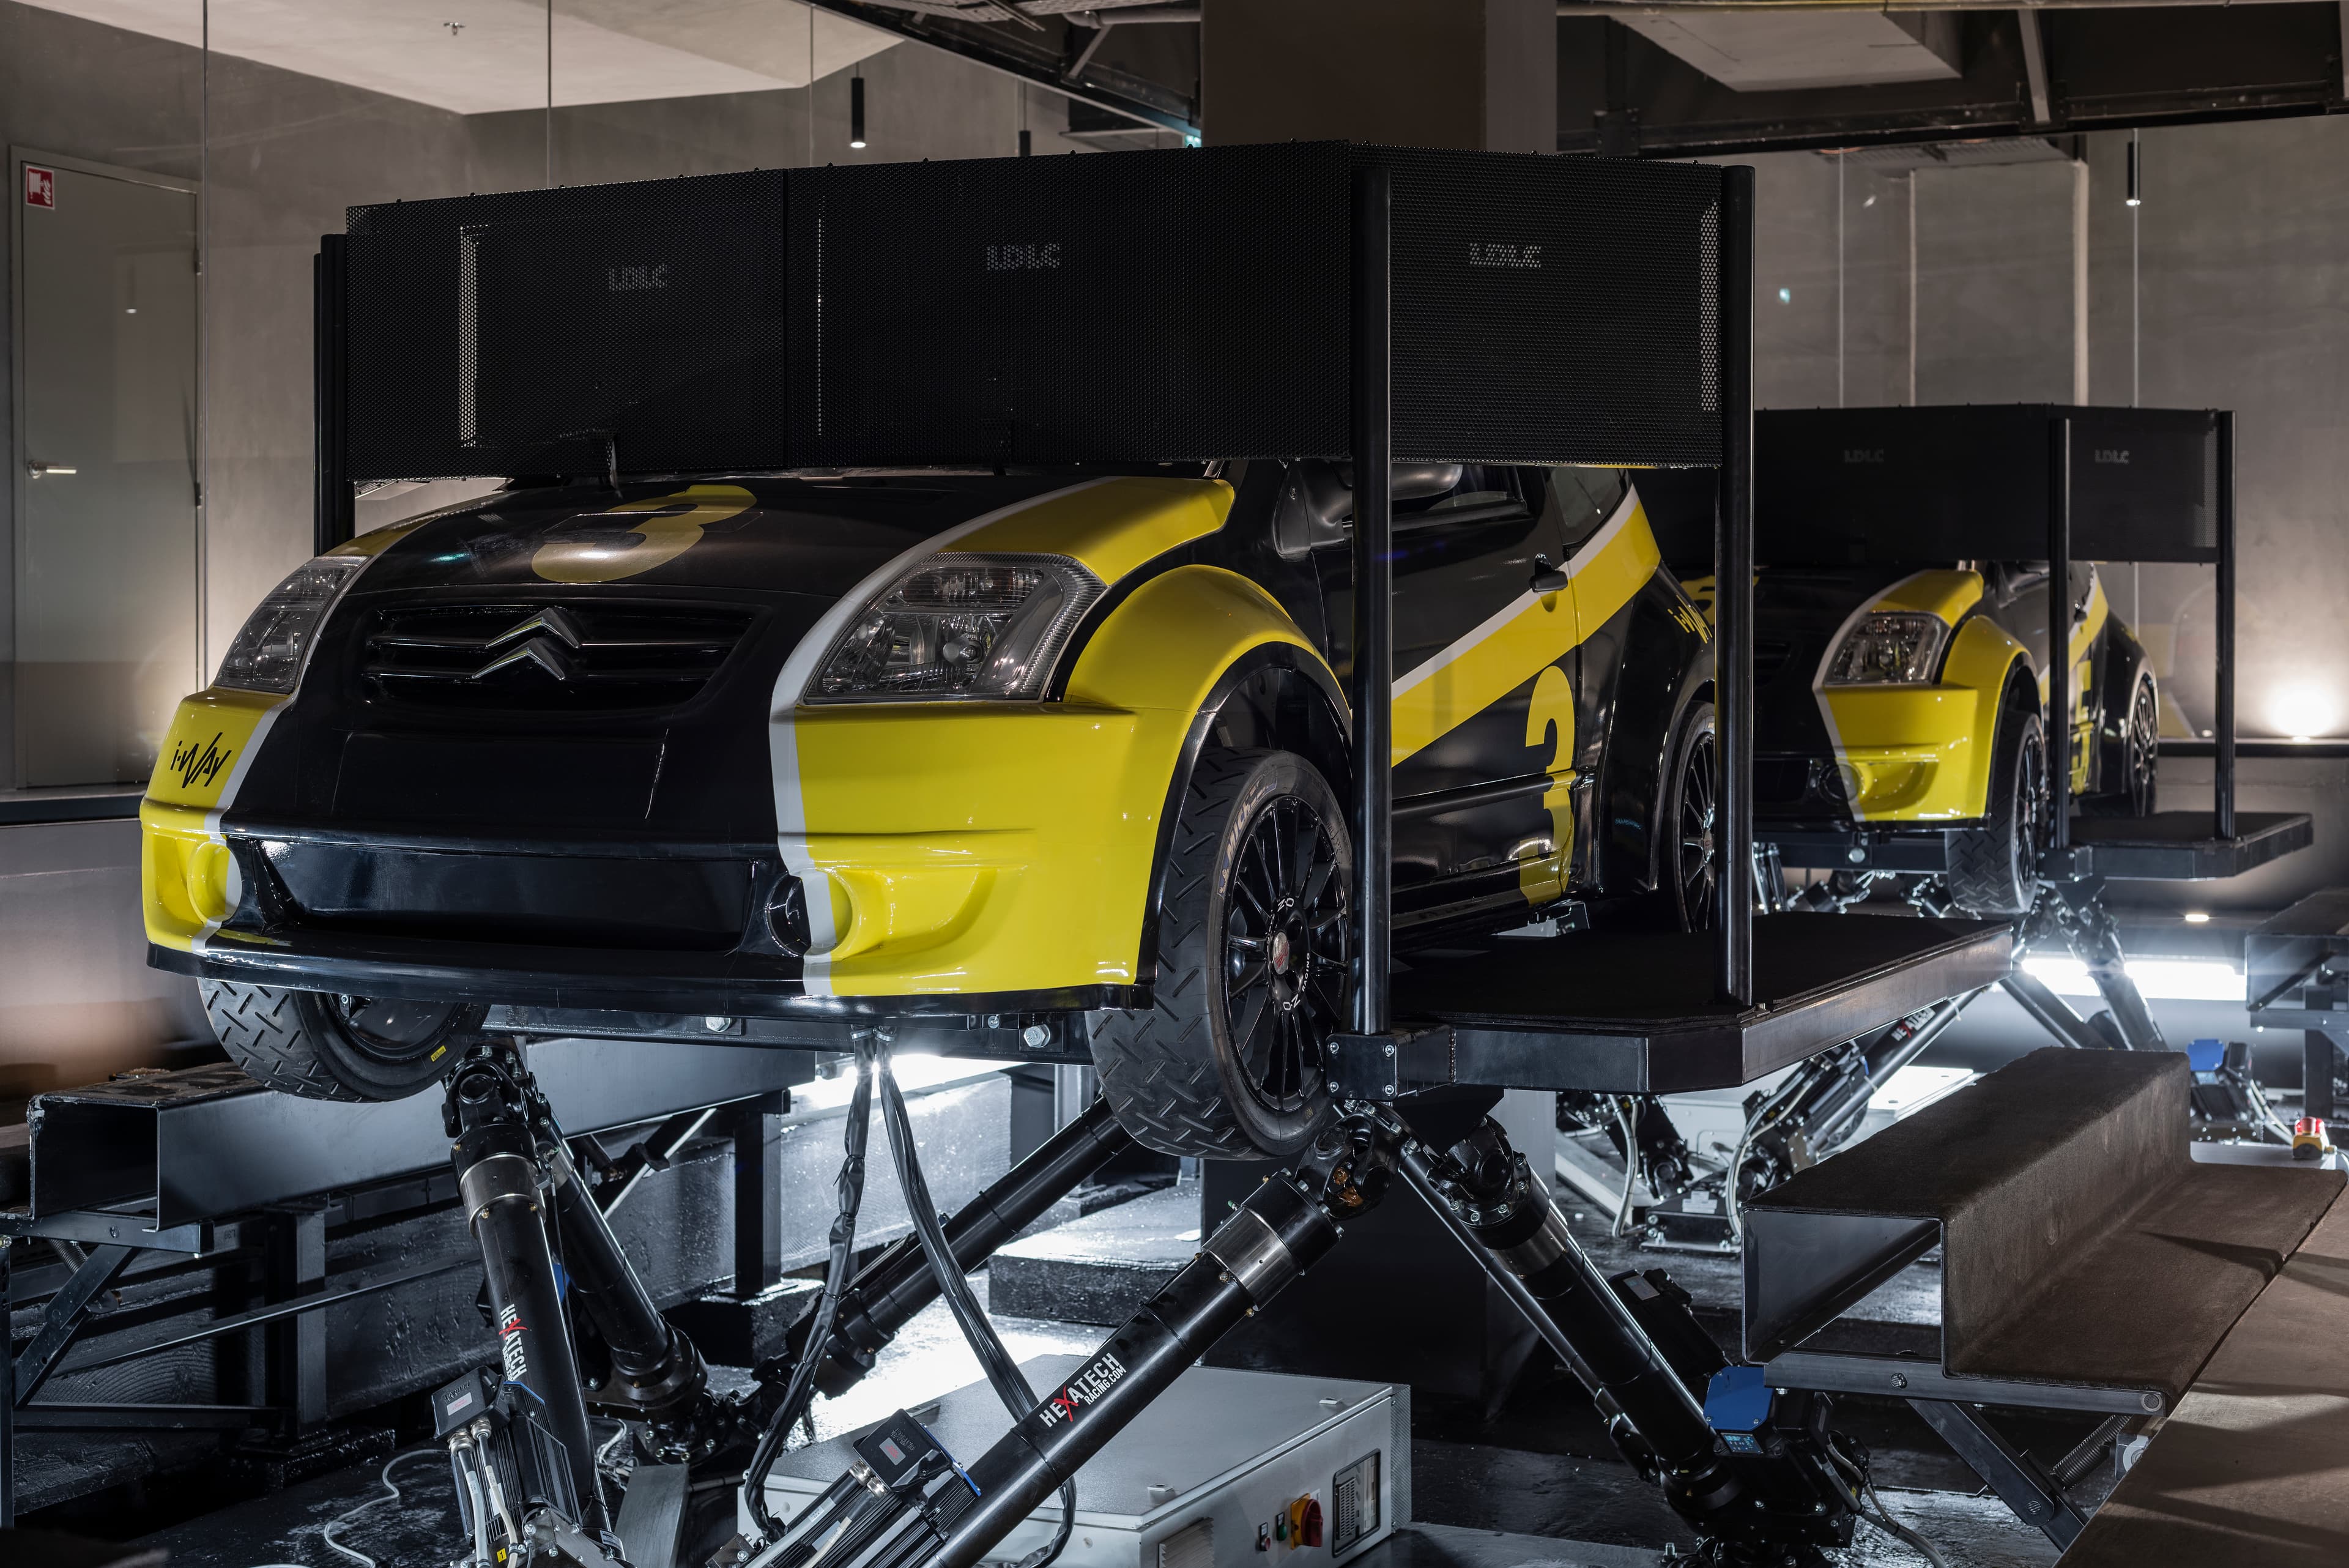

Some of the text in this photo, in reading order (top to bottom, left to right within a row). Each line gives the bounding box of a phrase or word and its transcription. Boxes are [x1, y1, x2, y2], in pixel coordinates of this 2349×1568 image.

[608, 264, 668, 291] LDLC
[986, 243, 1061, 270] LDLC
[1469, 243, 1541, 268] LDLC
[532, 485, 757, 582] 3
[1520, 666, 1576, 905] 3
[499, 1304, 528, 1381] HEXATECH
[1039, 1353, 1120, 1428] HEXATECH
[1083, 1365, 1127, 1405] RACING.COM
